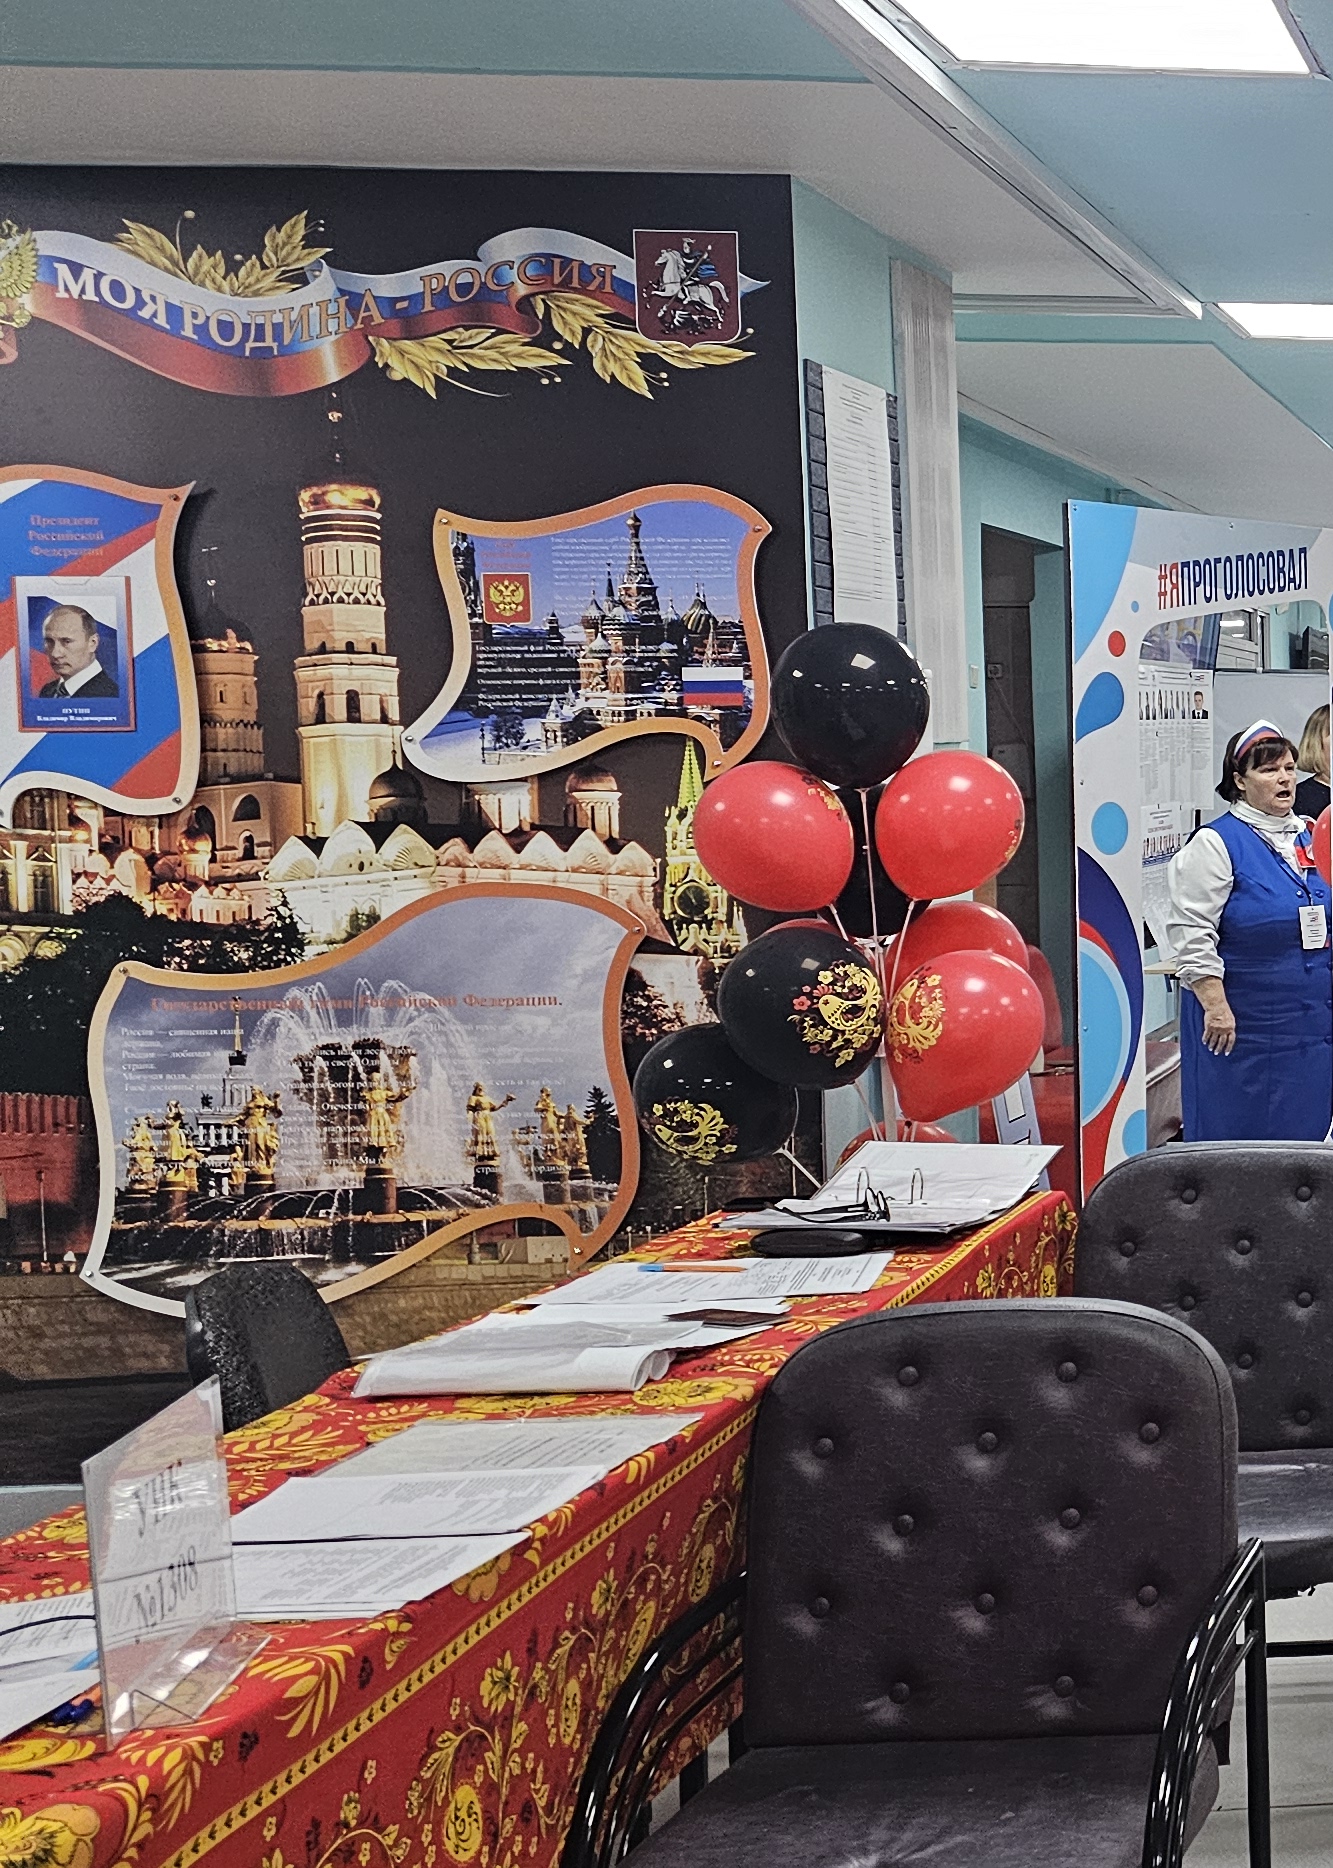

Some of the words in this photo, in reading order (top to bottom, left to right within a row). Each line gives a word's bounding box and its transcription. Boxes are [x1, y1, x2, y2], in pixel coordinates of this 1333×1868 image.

[55, 262, 170, 323] МОЯ
[180, 290, 386, 357] РОДИНА
[420, 260, 616, 311] РОССИЯ
[1158, 547, 1308, 610] #ЯПРОГОЛОСОВАЛ
